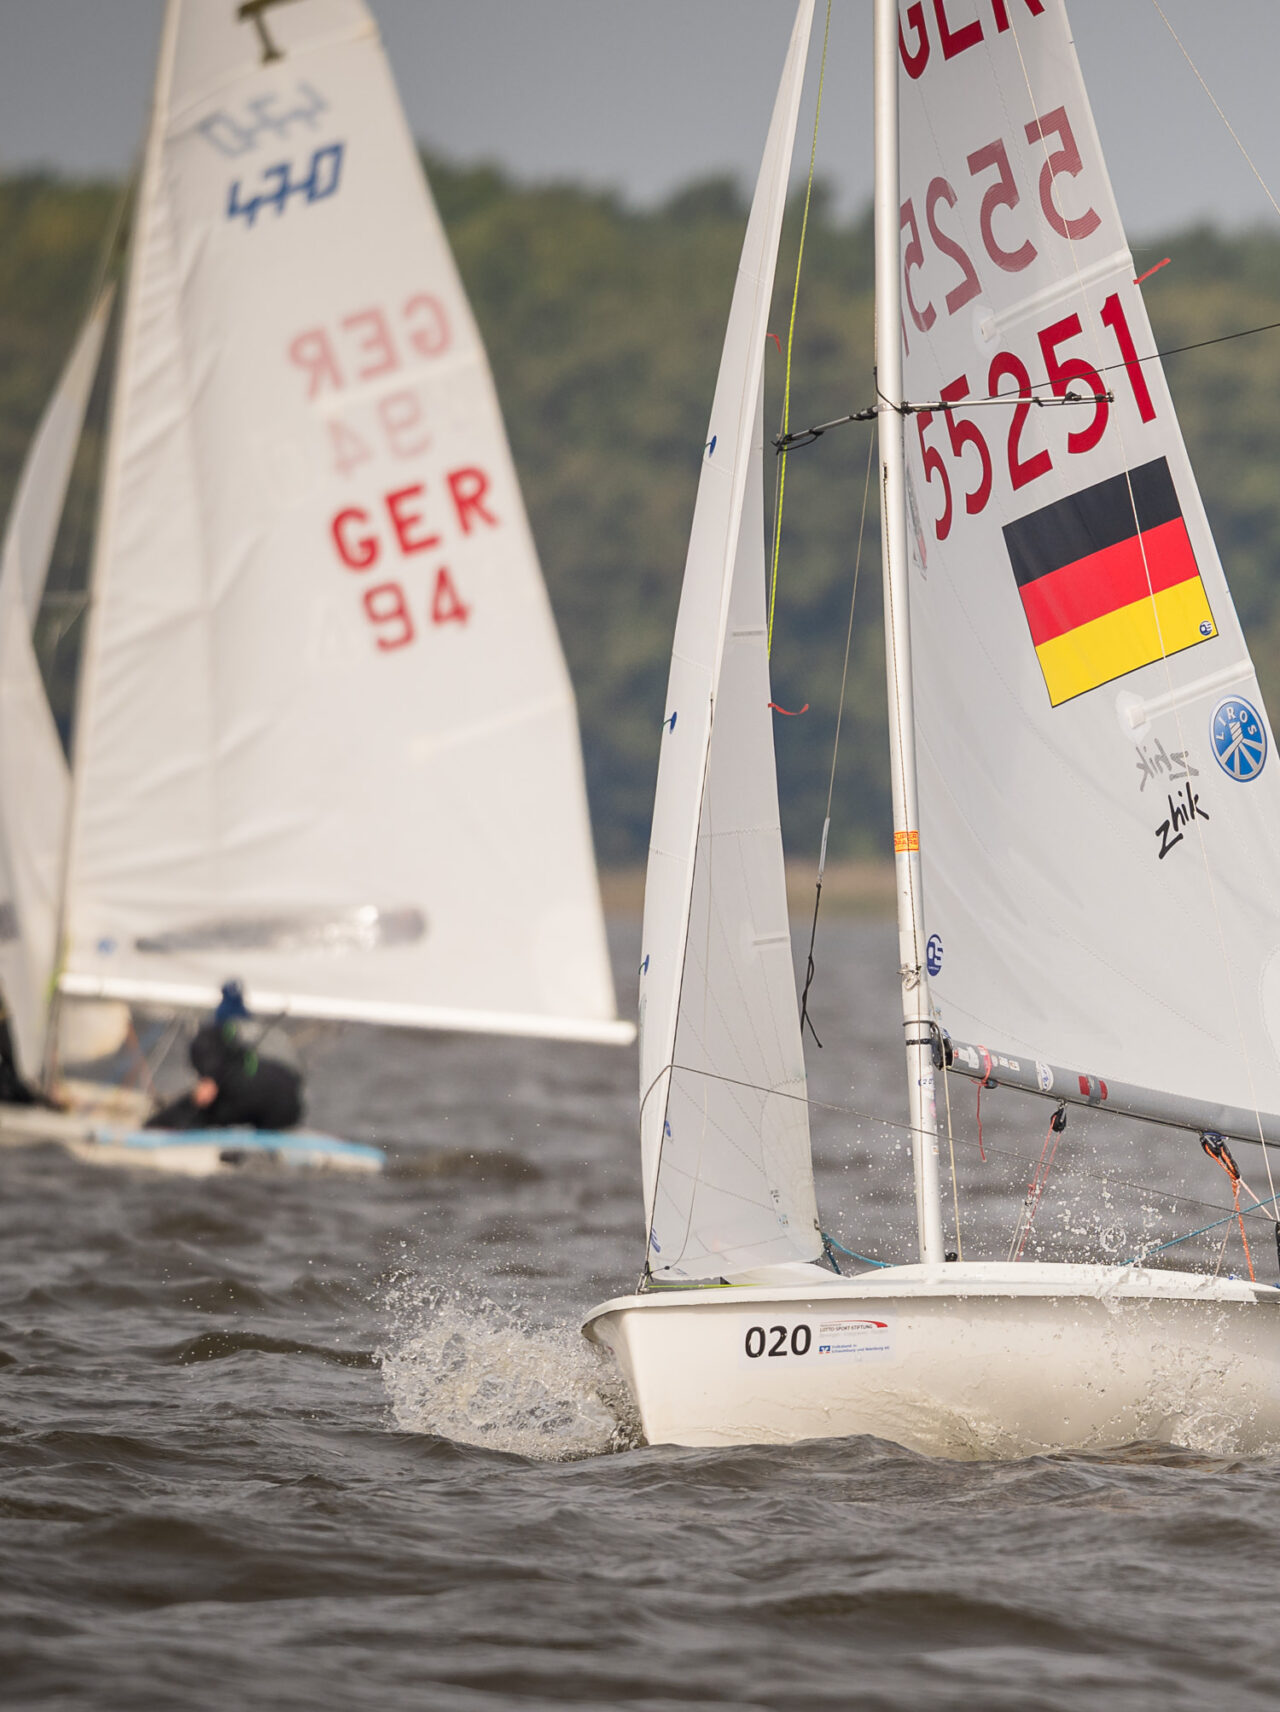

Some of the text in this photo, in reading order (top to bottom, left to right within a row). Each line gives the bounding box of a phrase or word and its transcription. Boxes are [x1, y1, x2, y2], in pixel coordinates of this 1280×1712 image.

[227, 141, 346, 230] 470
[917, 293, 1156, 541] 55251
[331, 467, 501, 571] GER
[363, 567, 470, 652] 94
[1216, 706, 1257, 741] LIROS
[1155, 782, 1209, 859] zhik
[745, 1324, 812, 1358] 020
